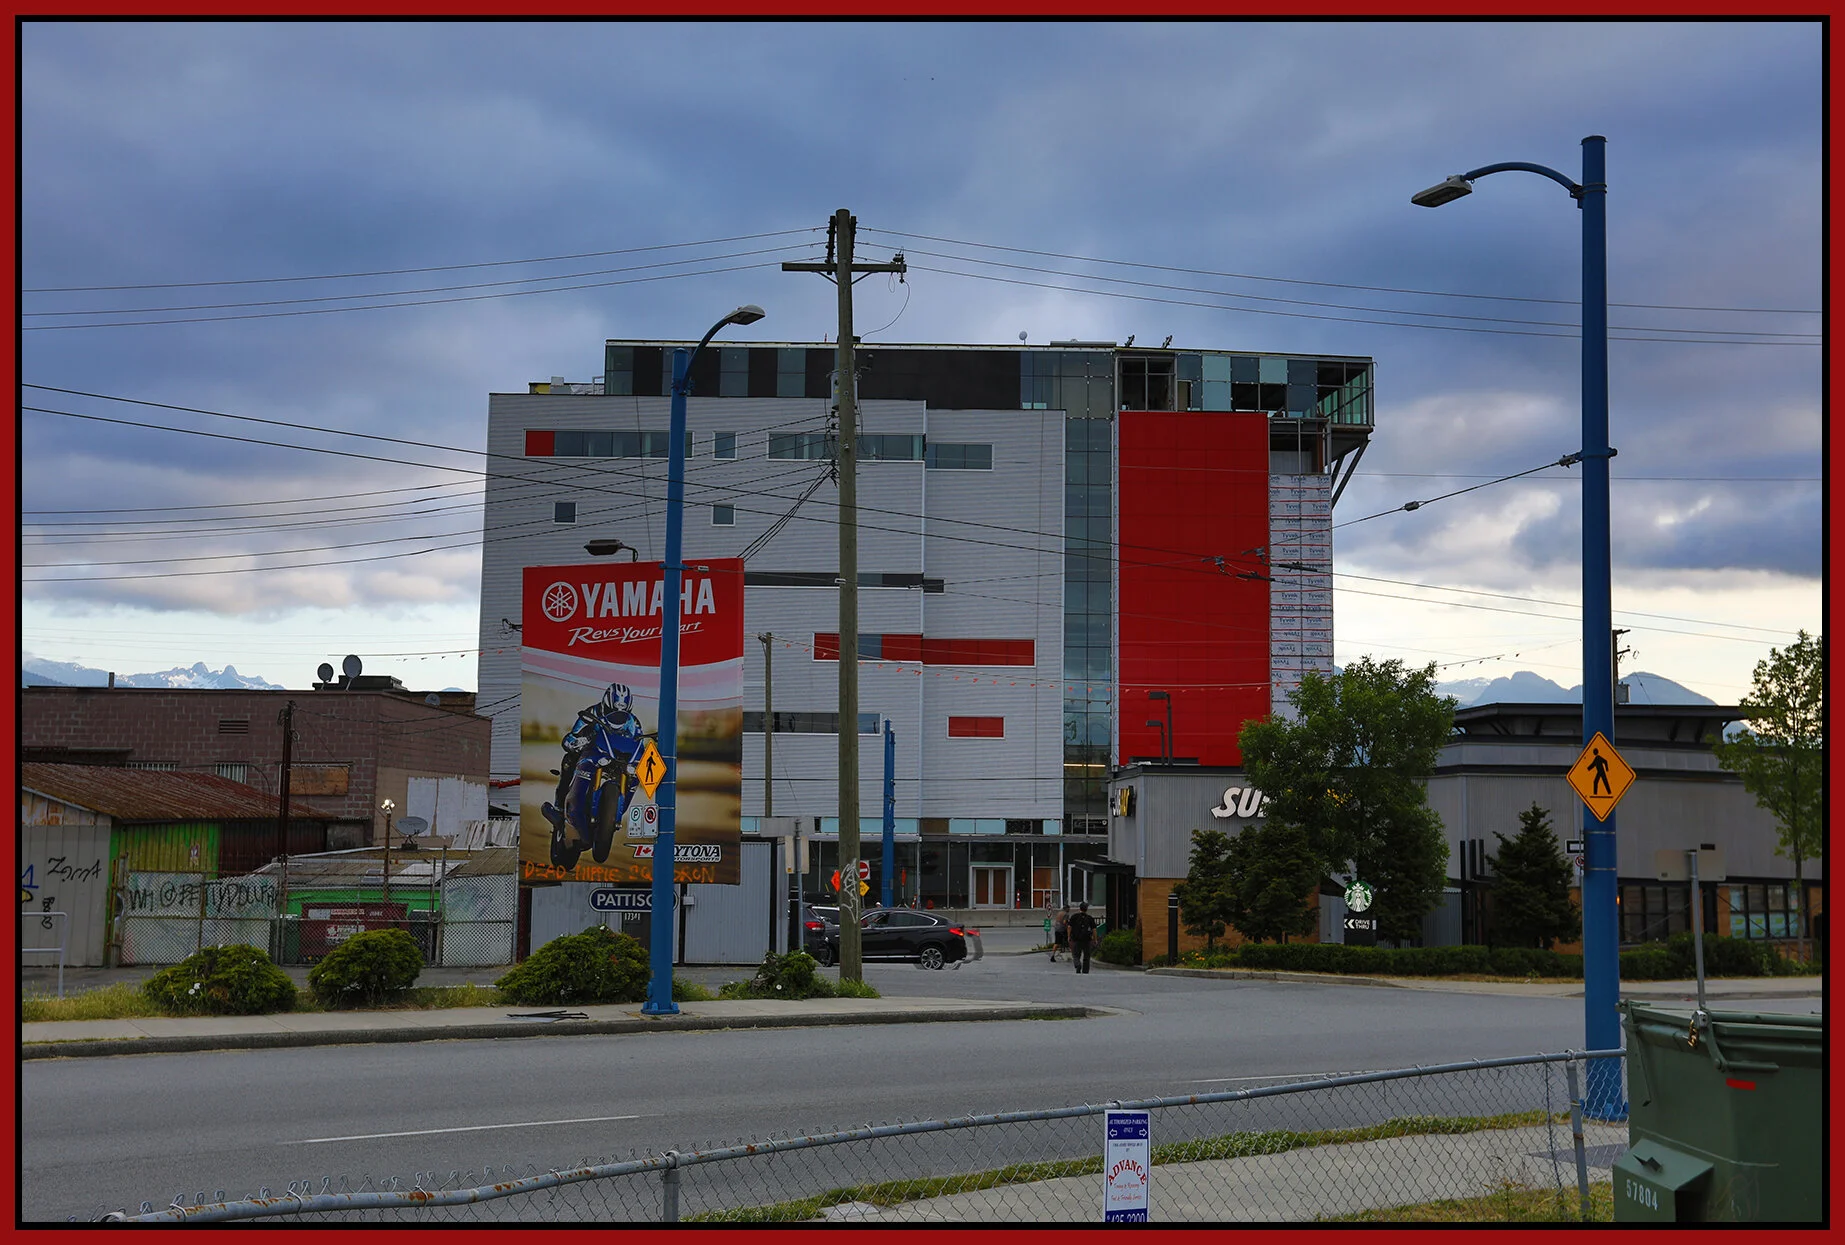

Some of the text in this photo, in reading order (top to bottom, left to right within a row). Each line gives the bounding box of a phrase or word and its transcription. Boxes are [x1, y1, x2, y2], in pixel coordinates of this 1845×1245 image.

[581, 578, 716, 618] YAMAHA
[568, 626, 621, 646] Revs
[620, 625, 660, 643] Your
[674, 846, 720, 857] YTONA
[525, 861, 566, 879] DEAD
[597, 894, 653, 907] PATTISO
[1108, 1159, 1147, 1185] ADVANCE
[1626, 1179, 1658, 1211] 57804
